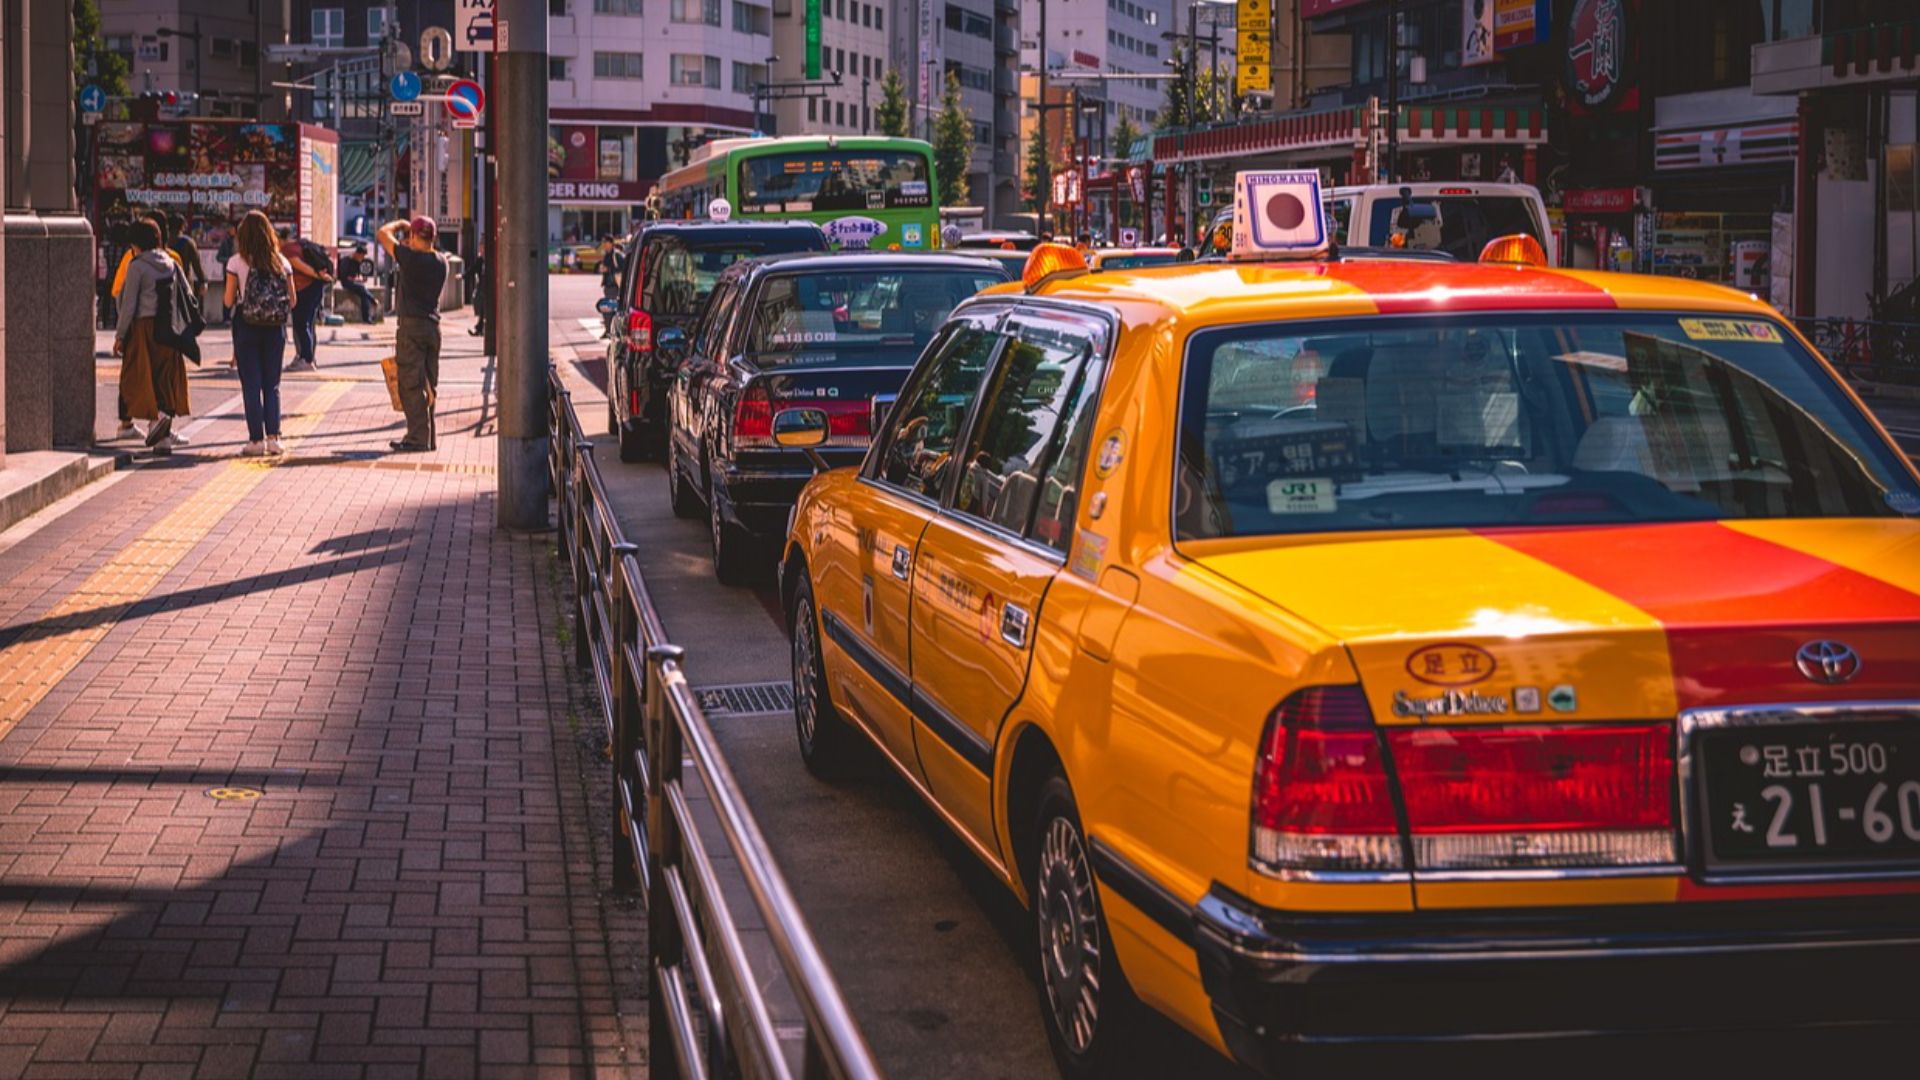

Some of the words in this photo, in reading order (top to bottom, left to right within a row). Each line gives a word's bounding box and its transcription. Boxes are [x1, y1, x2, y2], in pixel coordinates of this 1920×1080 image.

[1250, 175, 1314, 184] HINOMARU
[126, 189, 191, 203] Welcome
[192, 189, 206, 203] to
[208, 189, 242, 203] Taito
[243, 189, 273, 207] City
[578, 182, 620, 198] KING
[893, 196, 929, 205] HINO
[1281, 482, 1306, 495] JR
[1424, 652, 1481, 675] 足立
[1394, 687, 1446, 723] Super
[1447, 689, 1507, 715] Deluxe
[1762, 744, 1825, 777] 足立
[1830, 742, 1887, 776] 500
[1731, 801, 1754, 833] え
